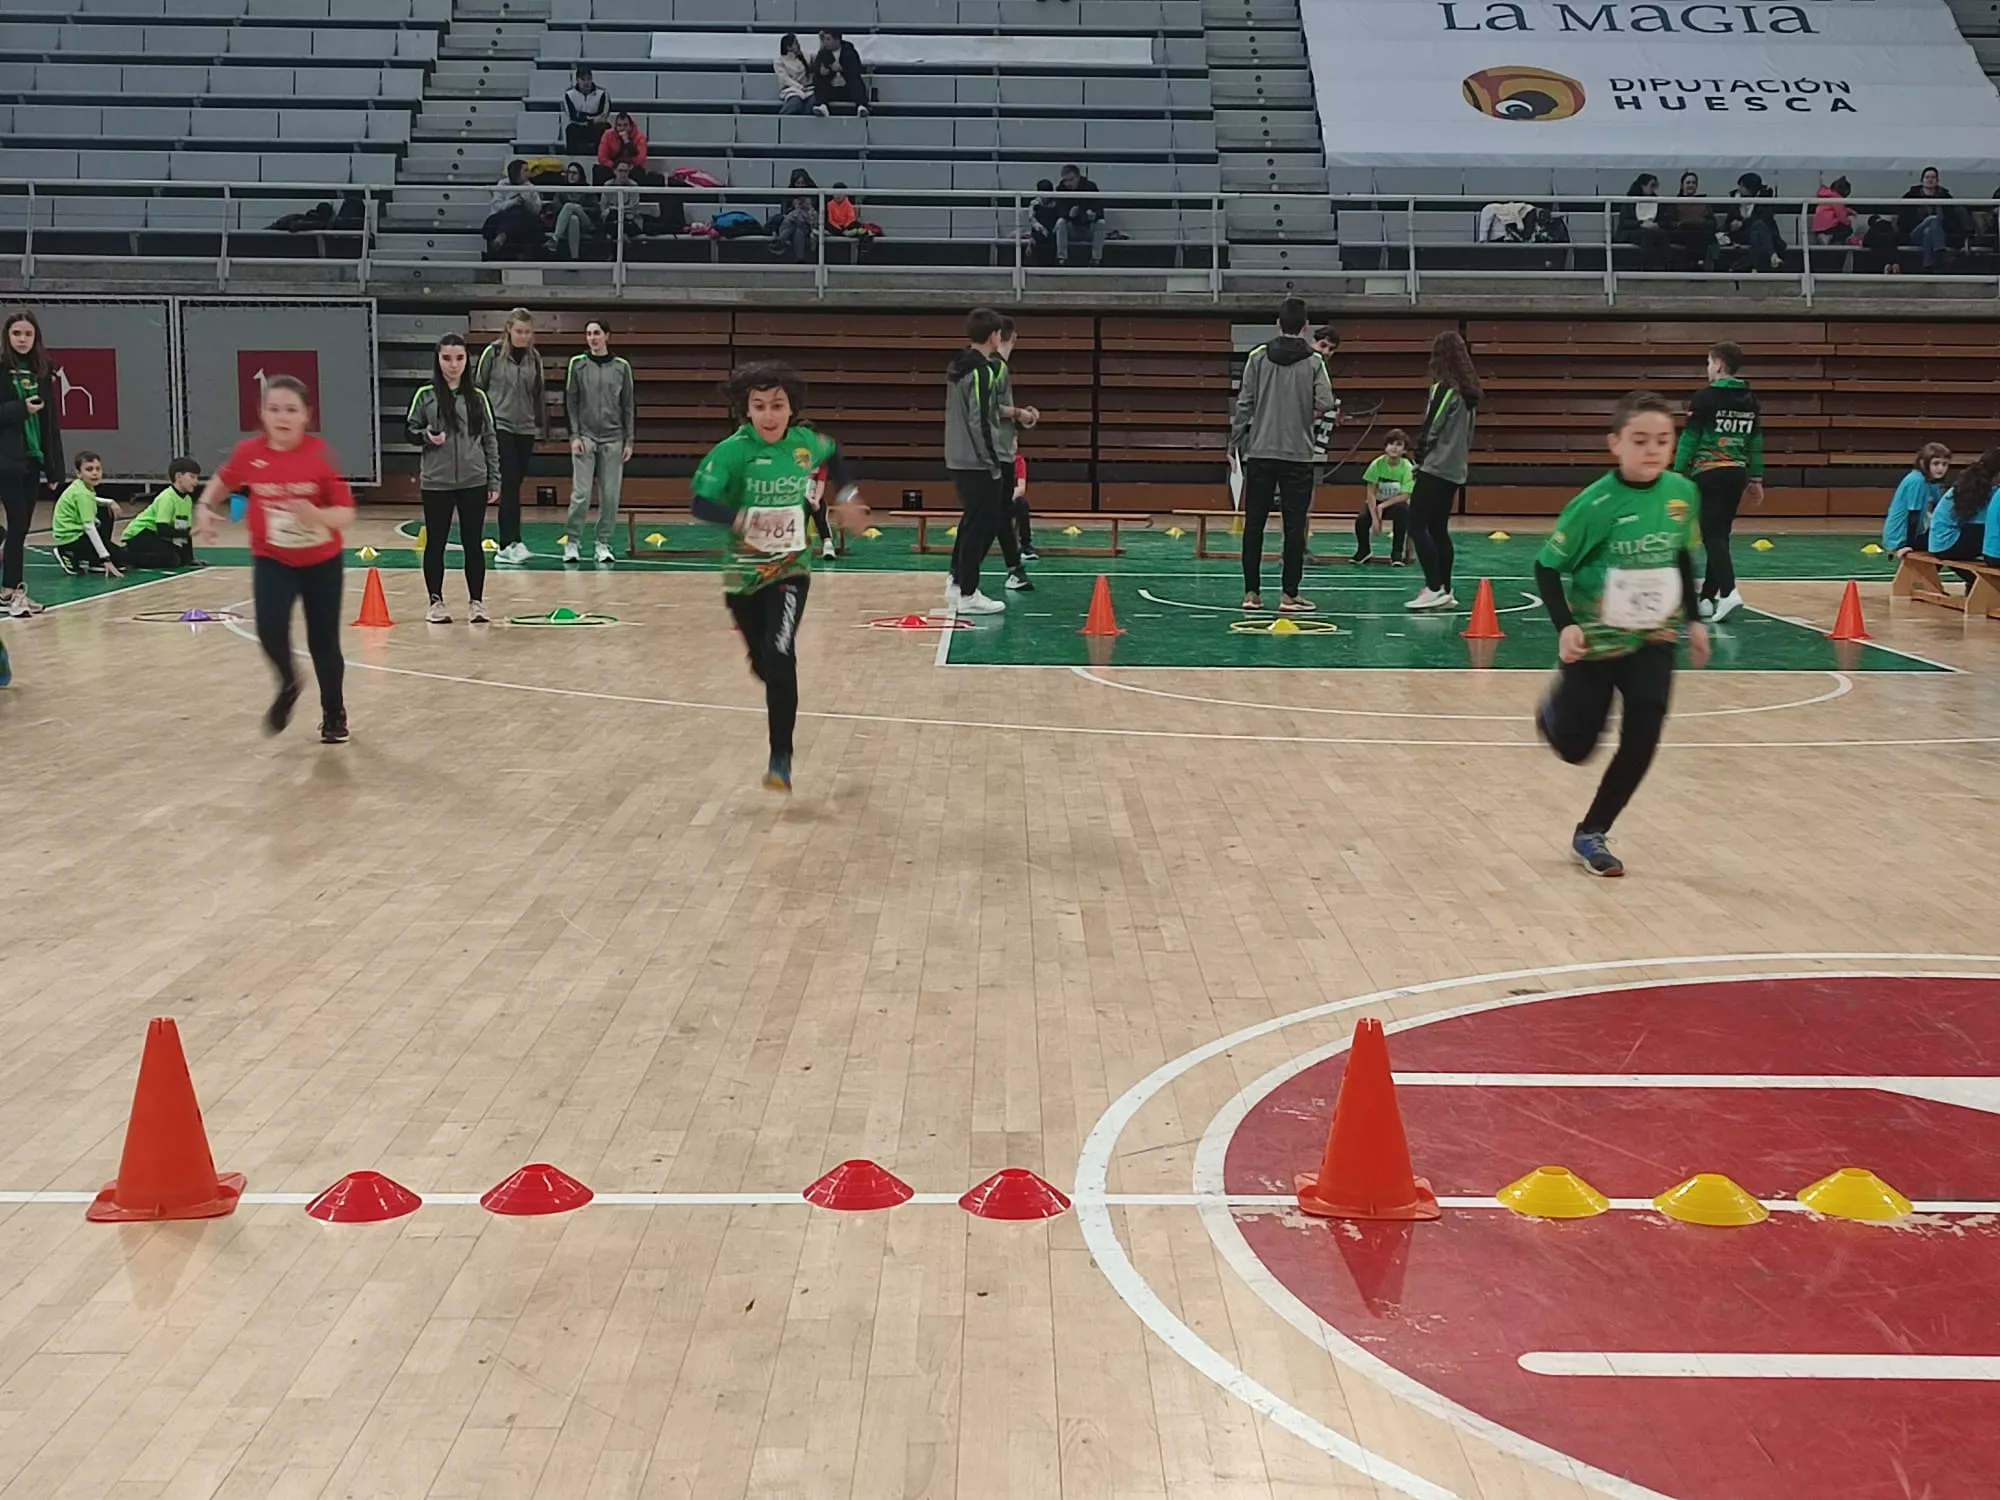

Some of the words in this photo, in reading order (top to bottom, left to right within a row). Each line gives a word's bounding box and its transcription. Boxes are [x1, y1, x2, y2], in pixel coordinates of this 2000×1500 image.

[1437, 2, 1535, 31] La
[1609, 77, 1851, 94] DIPUTACIÓN
[1614, 95, 1858, 113] HUESCA
[757, 517, 797, 539] 484
